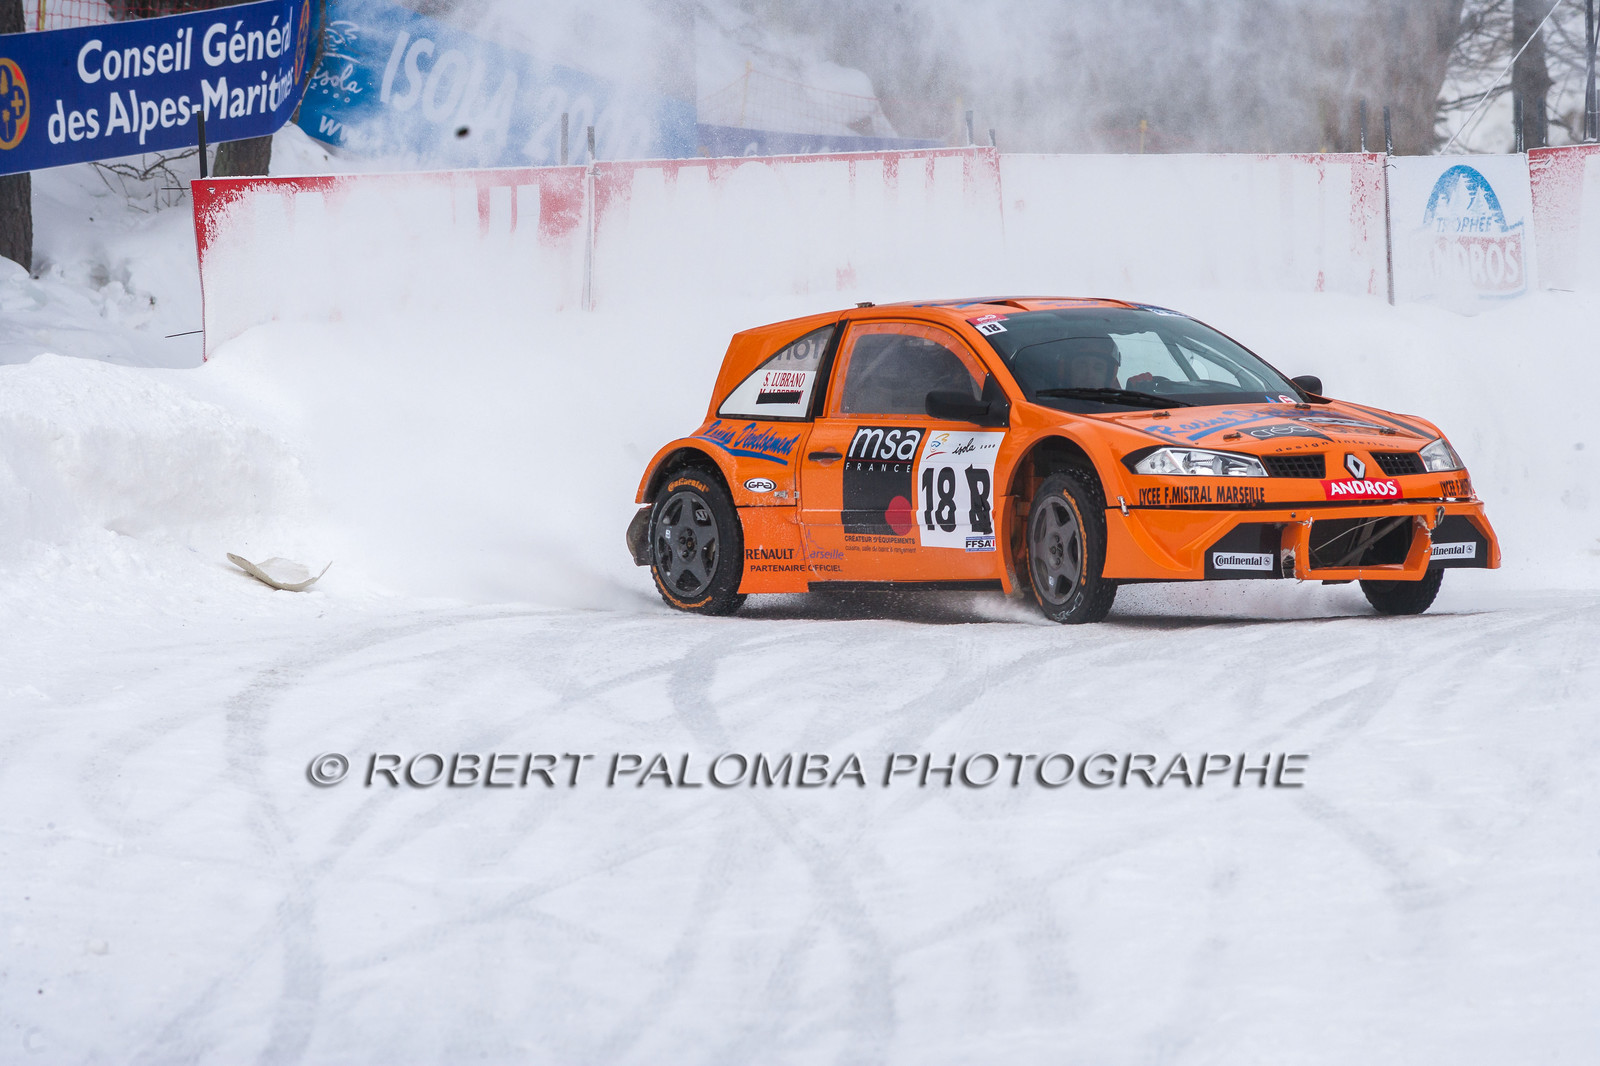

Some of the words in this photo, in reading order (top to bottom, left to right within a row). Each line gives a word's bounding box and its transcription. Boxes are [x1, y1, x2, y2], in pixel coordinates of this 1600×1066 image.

[77, 27, 192, 84] Conseil
[202, 7, 292, 67] Général
[48, 99, 99, 145] des
[981, 323, 1001, 333] 18
[763, 371, 769, 387] S.
[771, 372, 805, 388] LUBRANO
[845, 463, 911, 473] FRANCE
[1216, 486, 1266, 504] MARSEILLE
[1331, 480, 1397, 496] ANDROS
[922, 466, 957, 533] 18
[966, 540, 991, 548] FFSA
[745, 548, 794, 560] RENAULT
[1215, 555, 1262, 567] Continental
[750, 564, 806, 572] PARTENAIRE
[808, 564, 843, 572] OFFICIEL
